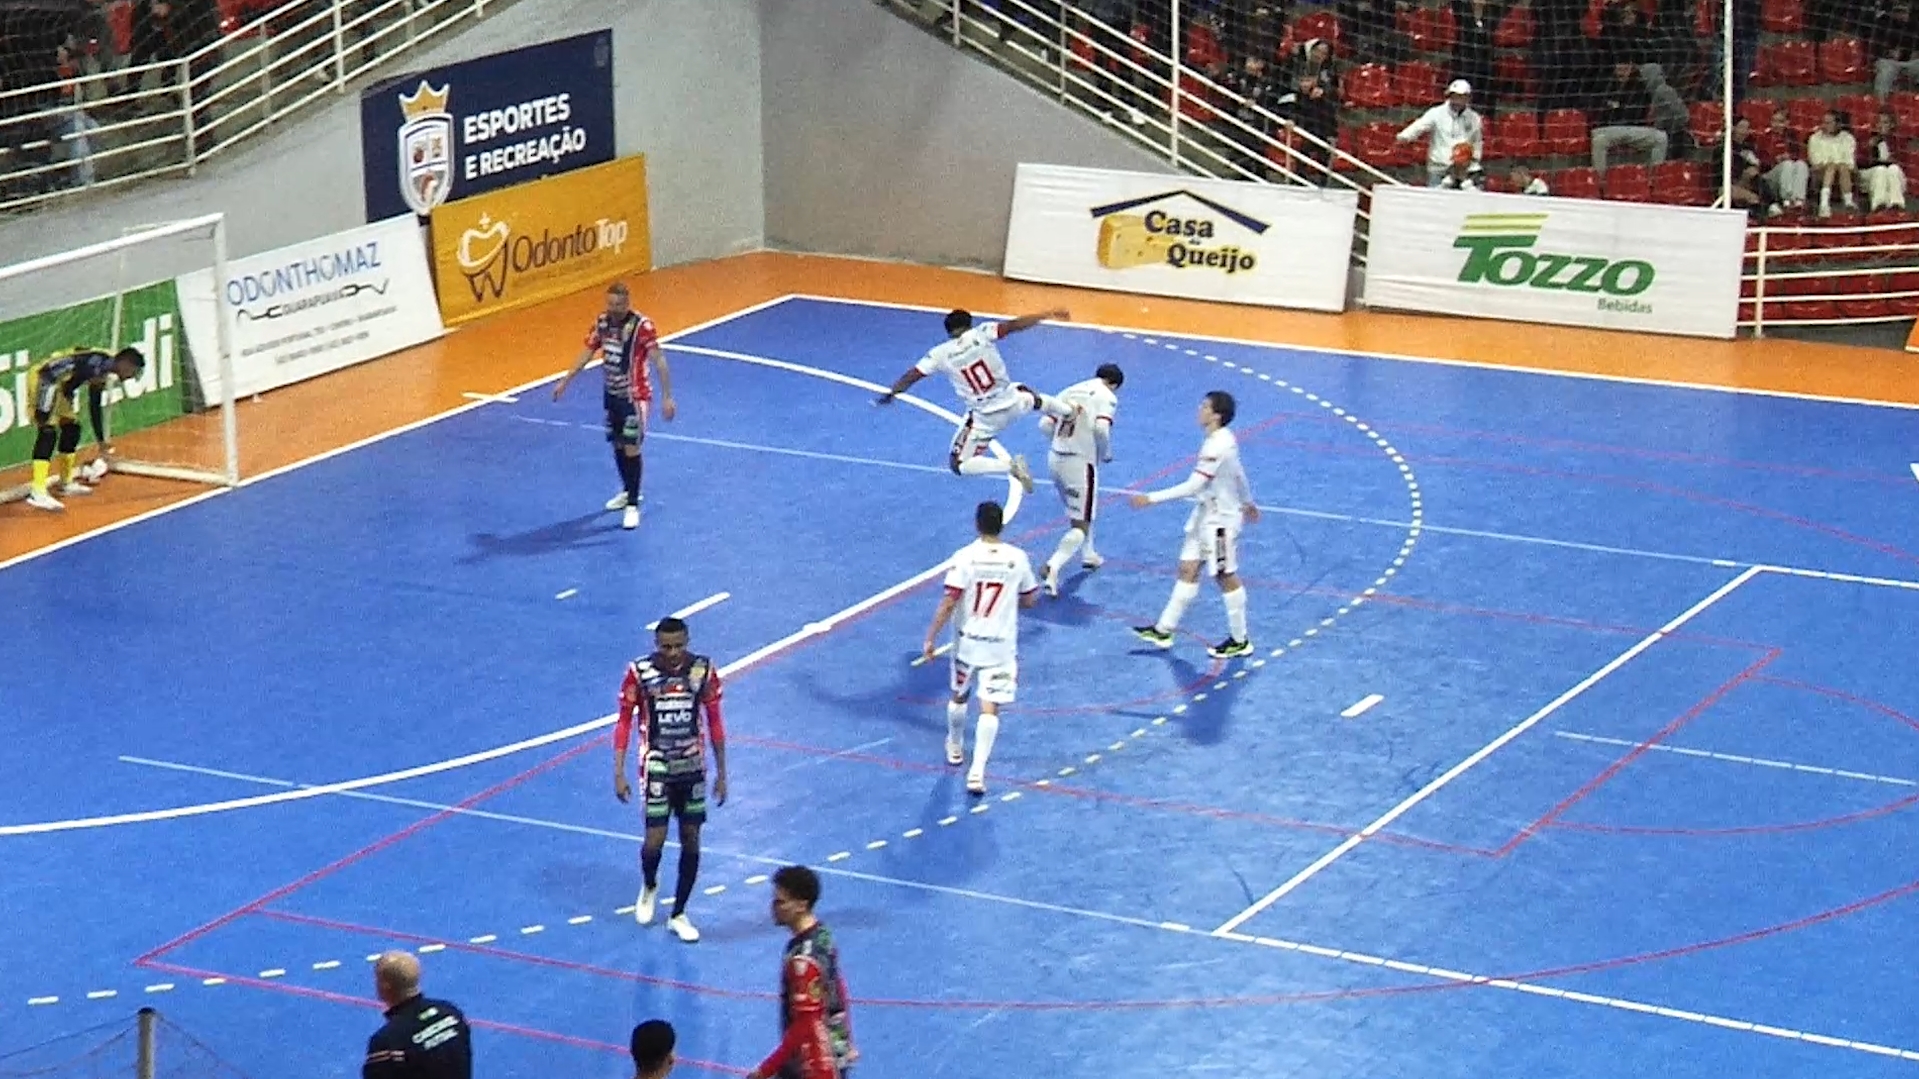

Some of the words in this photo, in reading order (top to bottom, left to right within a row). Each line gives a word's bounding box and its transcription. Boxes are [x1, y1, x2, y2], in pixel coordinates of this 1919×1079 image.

[463, 92, 571, 144] ESPORTES
[465, 155, 479, 180] E
[480, 127, 587, 176] RECREAÇÃO
[1144, 210, 1215, 238] Casa
[512, 218, 628, 273] OdontoTop
[1166, 244, 1256, 274] Queijo
[227, 241, 382, 306] ODONTHOMAZ
[1597, 298, 1653, 315] Bebidas
[961, 359, 996, 396] 10
[972, 570, 1005, 618] 17
[658, 709, 692, 723] LEVO
